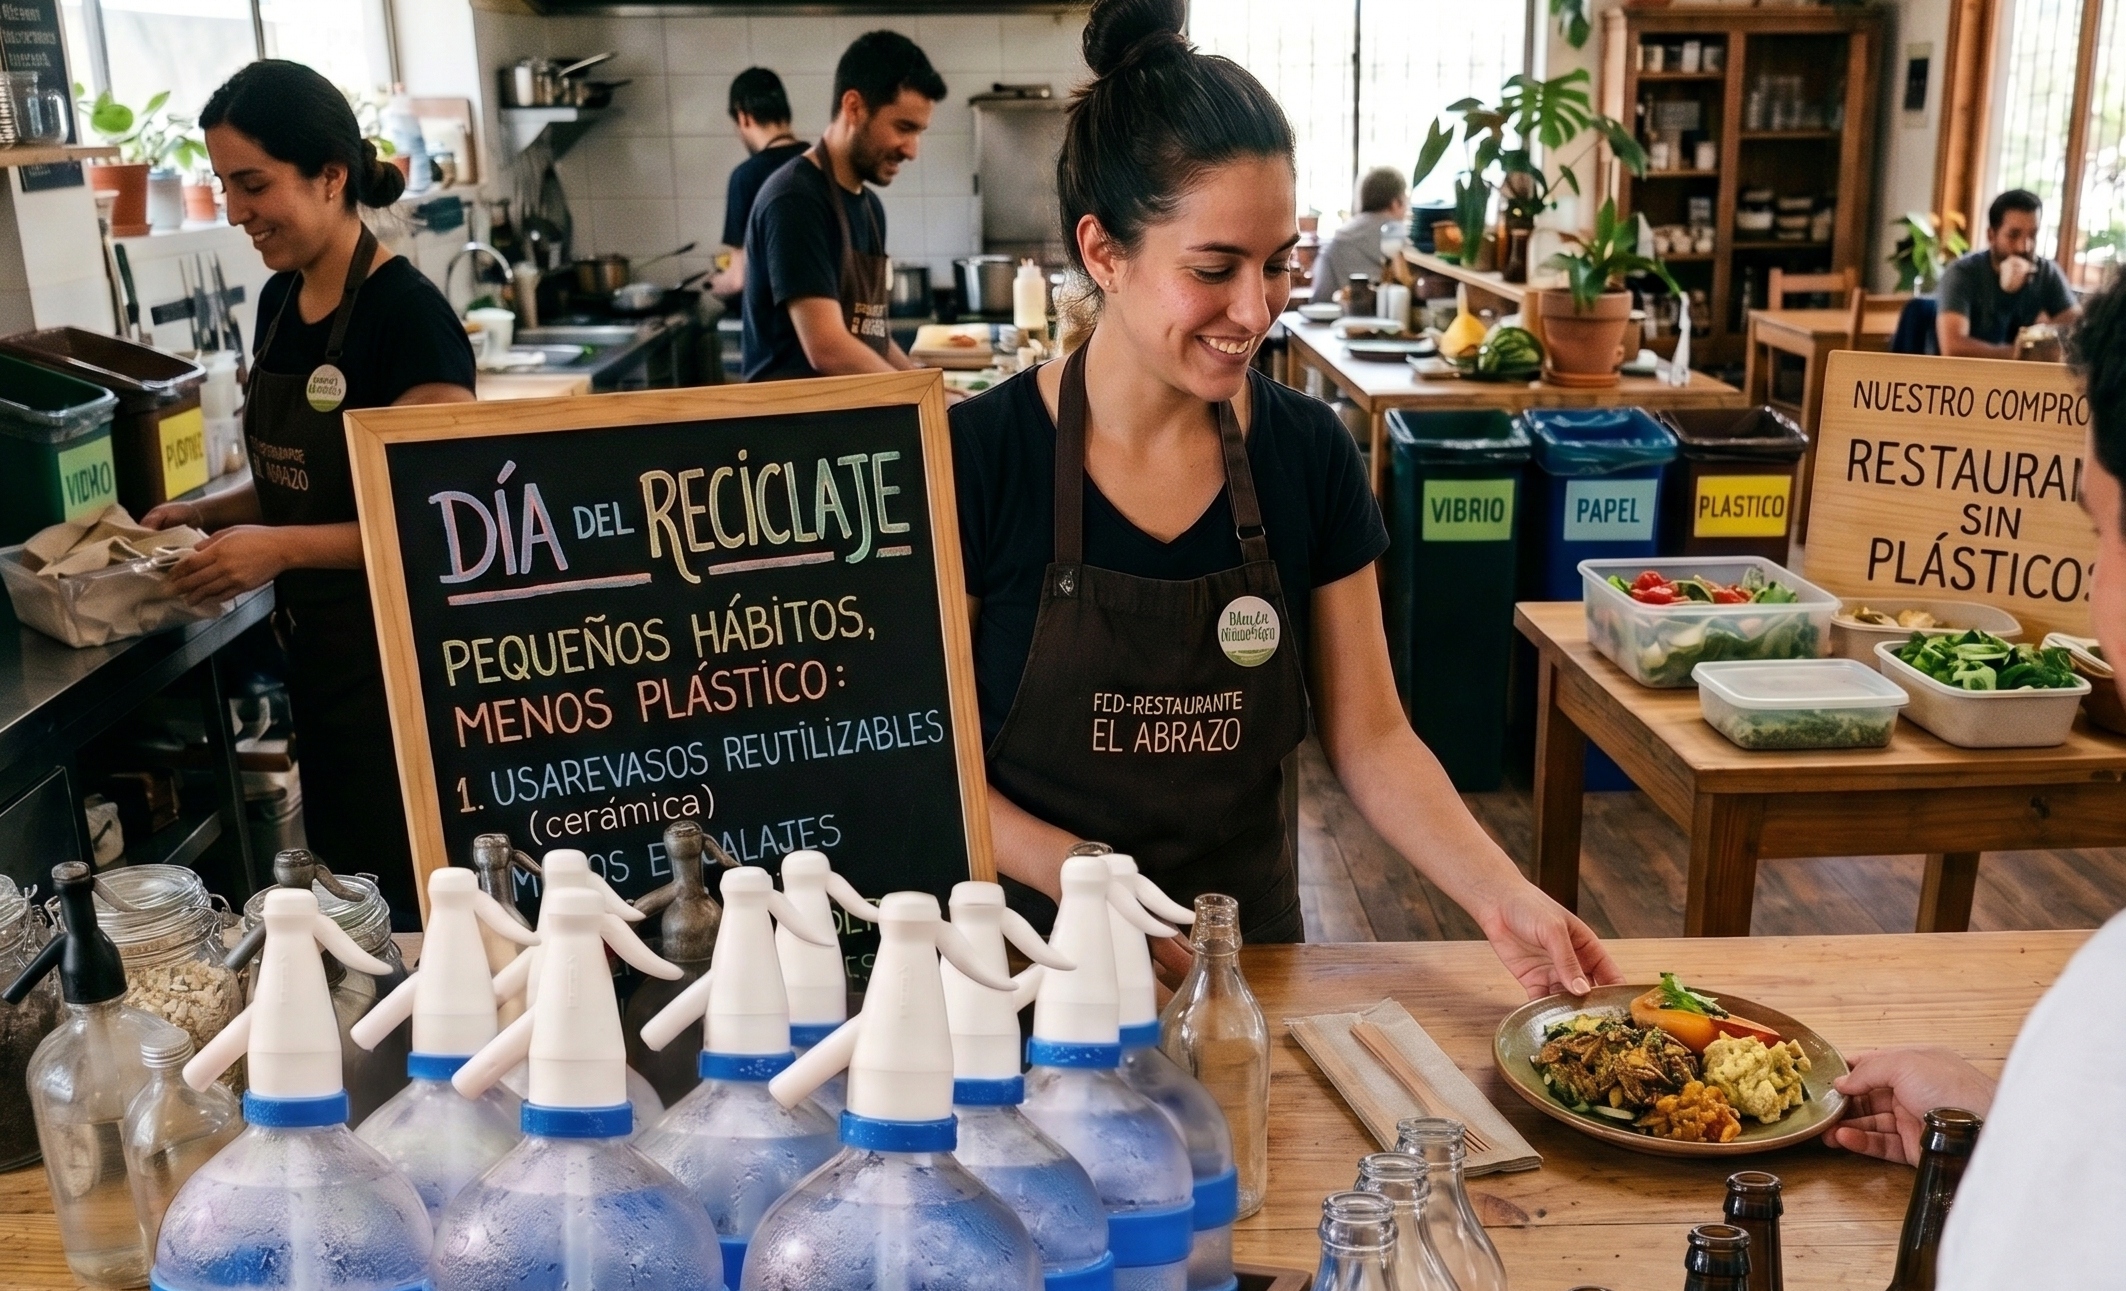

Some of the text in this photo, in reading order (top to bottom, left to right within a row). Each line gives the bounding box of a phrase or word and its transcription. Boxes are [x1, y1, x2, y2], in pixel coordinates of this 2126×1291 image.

[1853, 380, 1975, 418] NUESTRO
[428, 459, 569, 584] DÍA
[573, 501, 635, 540] DEL
[1430, 496, 1506, 524] VIBRIO
[1576, 497, 1640, 523] PAPEL
[1699, 494, 1785, 519] PLASTICO
[1960, 502, 2022, 541] SIN
[442, 613, 671, 687] PEQUEÑOS
[454, 688, 613, 748] MENOS
[1093, 717, 1241, 753] EL ABRAZO
[456, 776, 485, 813] 1.
[529, 783, 715, 846] (cerámica)
[511, 813, 842, 902] MOS EALAJES
